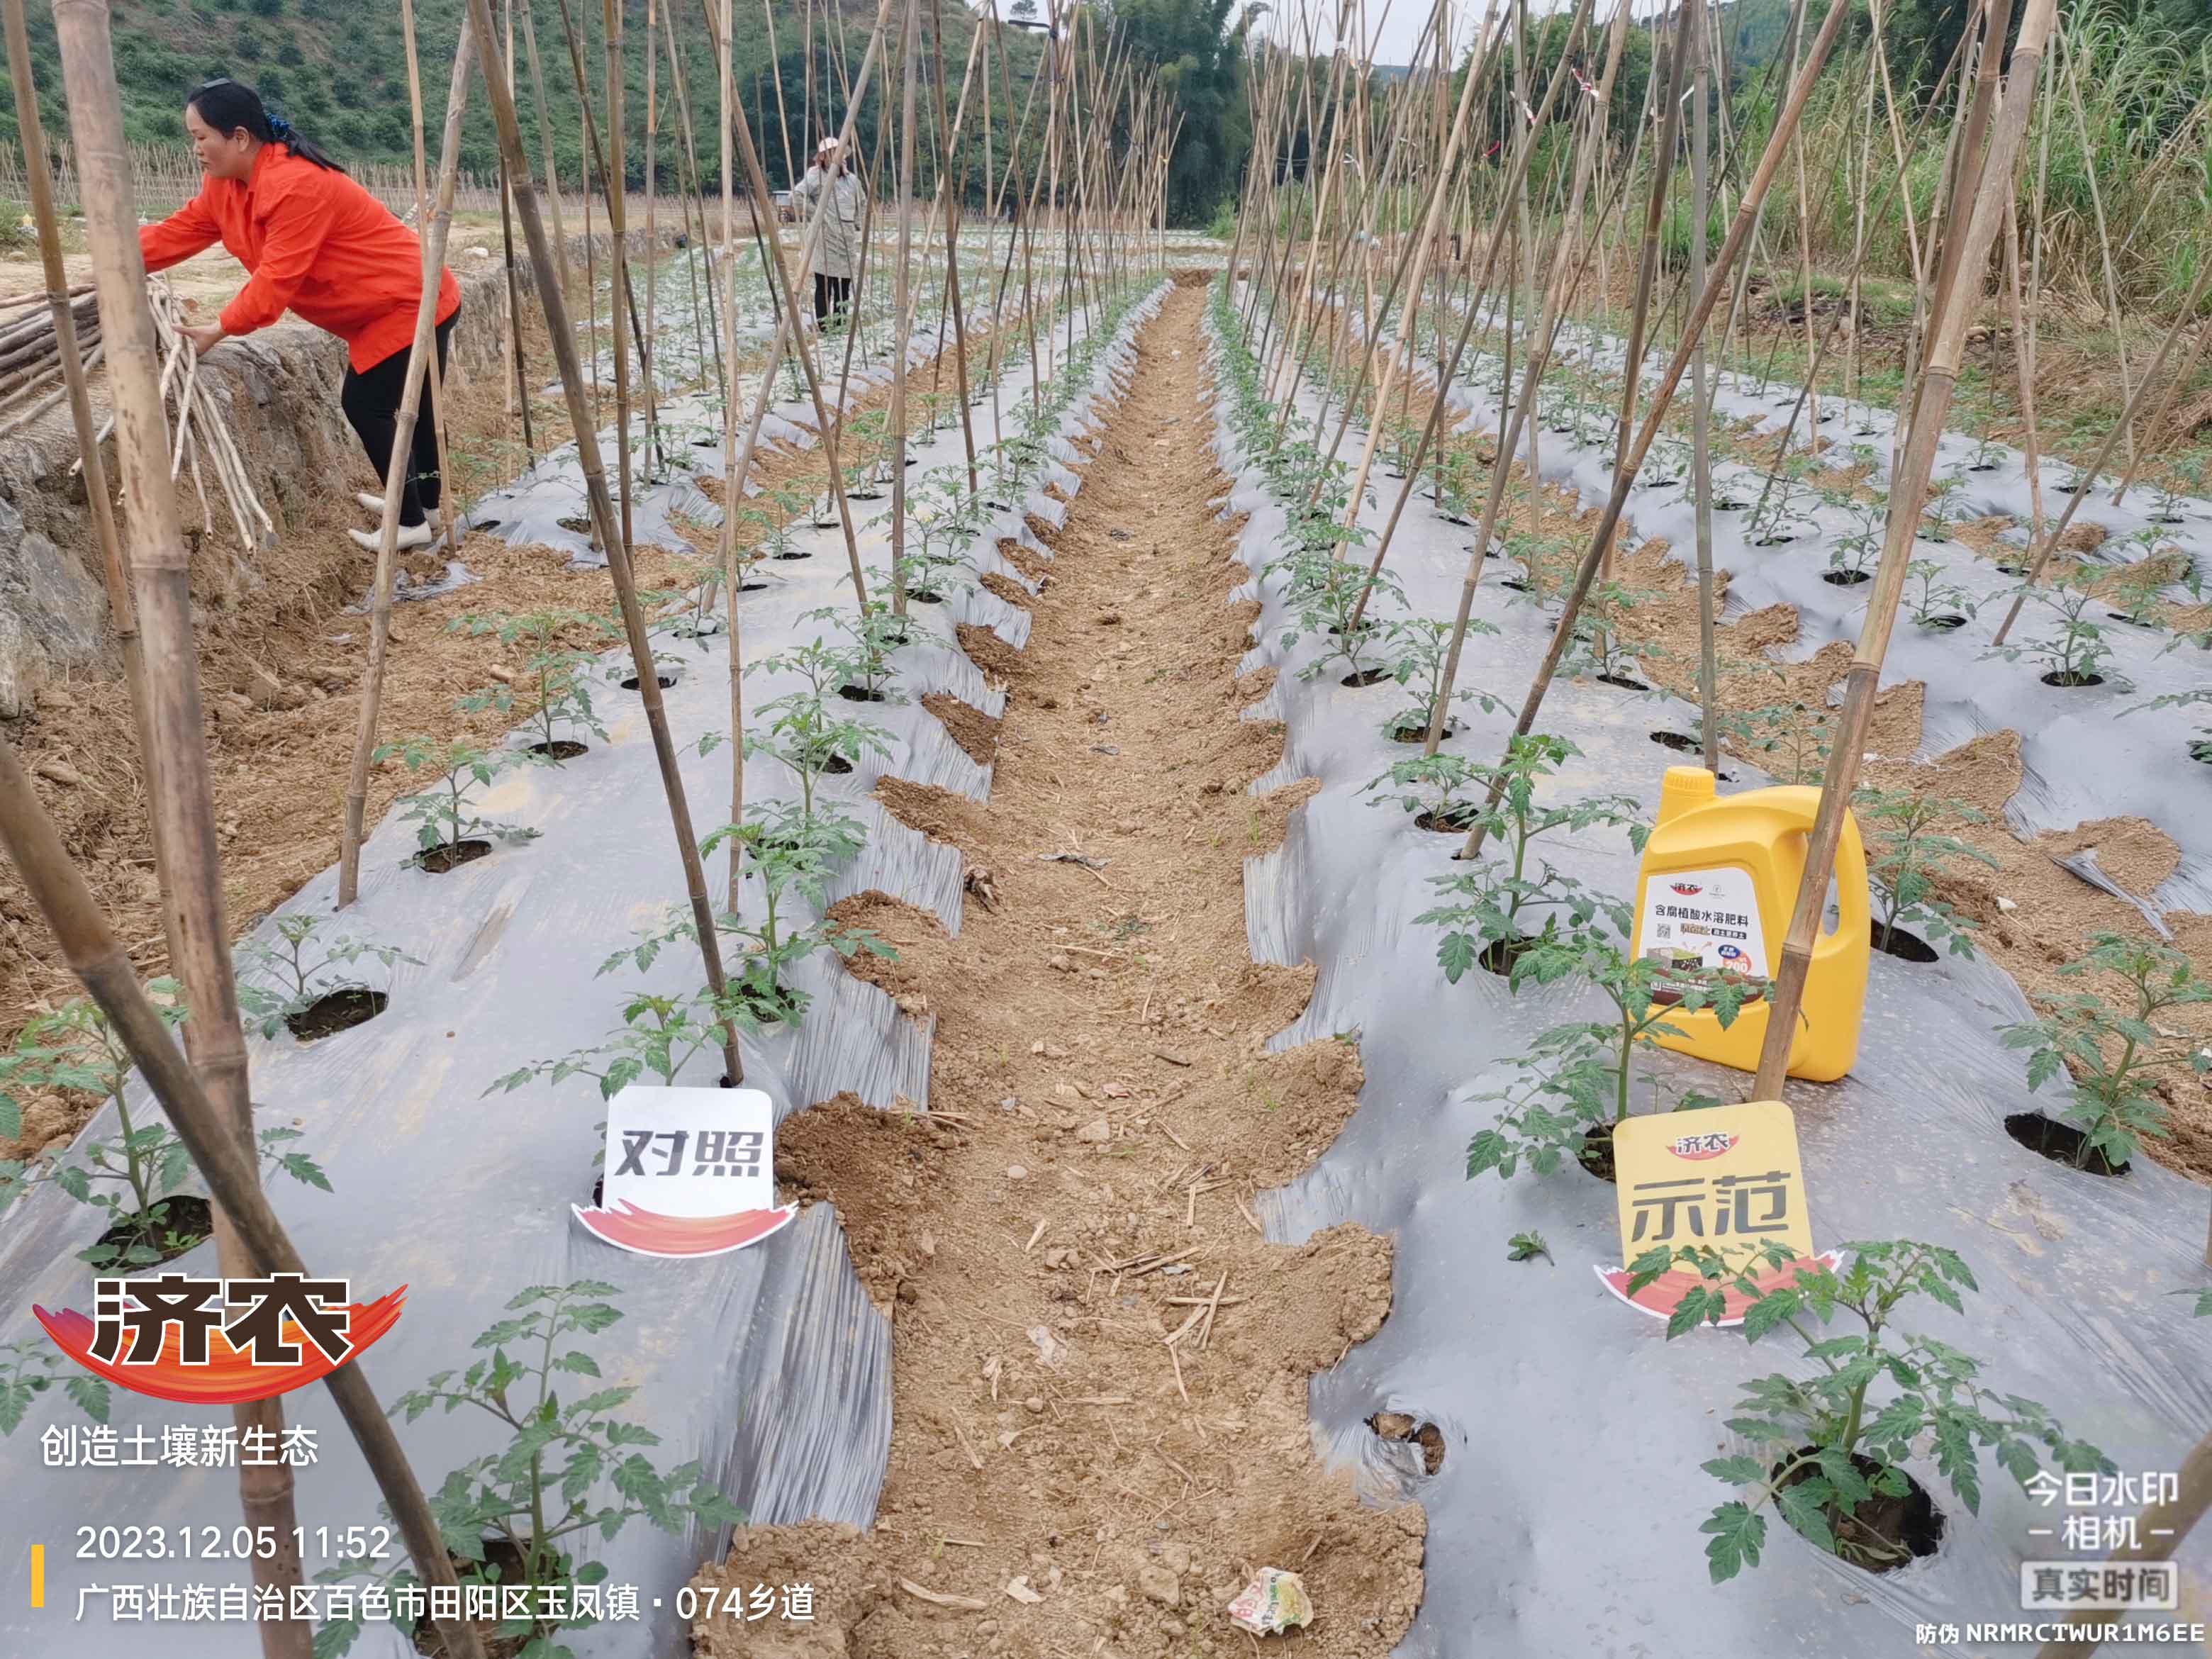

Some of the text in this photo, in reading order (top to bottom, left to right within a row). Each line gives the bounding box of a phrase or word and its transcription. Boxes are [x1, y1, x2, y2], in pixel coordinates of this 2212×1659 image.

[1655, 904, 1748, 926] 含腐植酸水溶肥料
[614, 1130, 764, 1178] 对照
[1676, 1133, 1730, 1154] 济农
[1631, 1170, 1791, 1242] 示范
